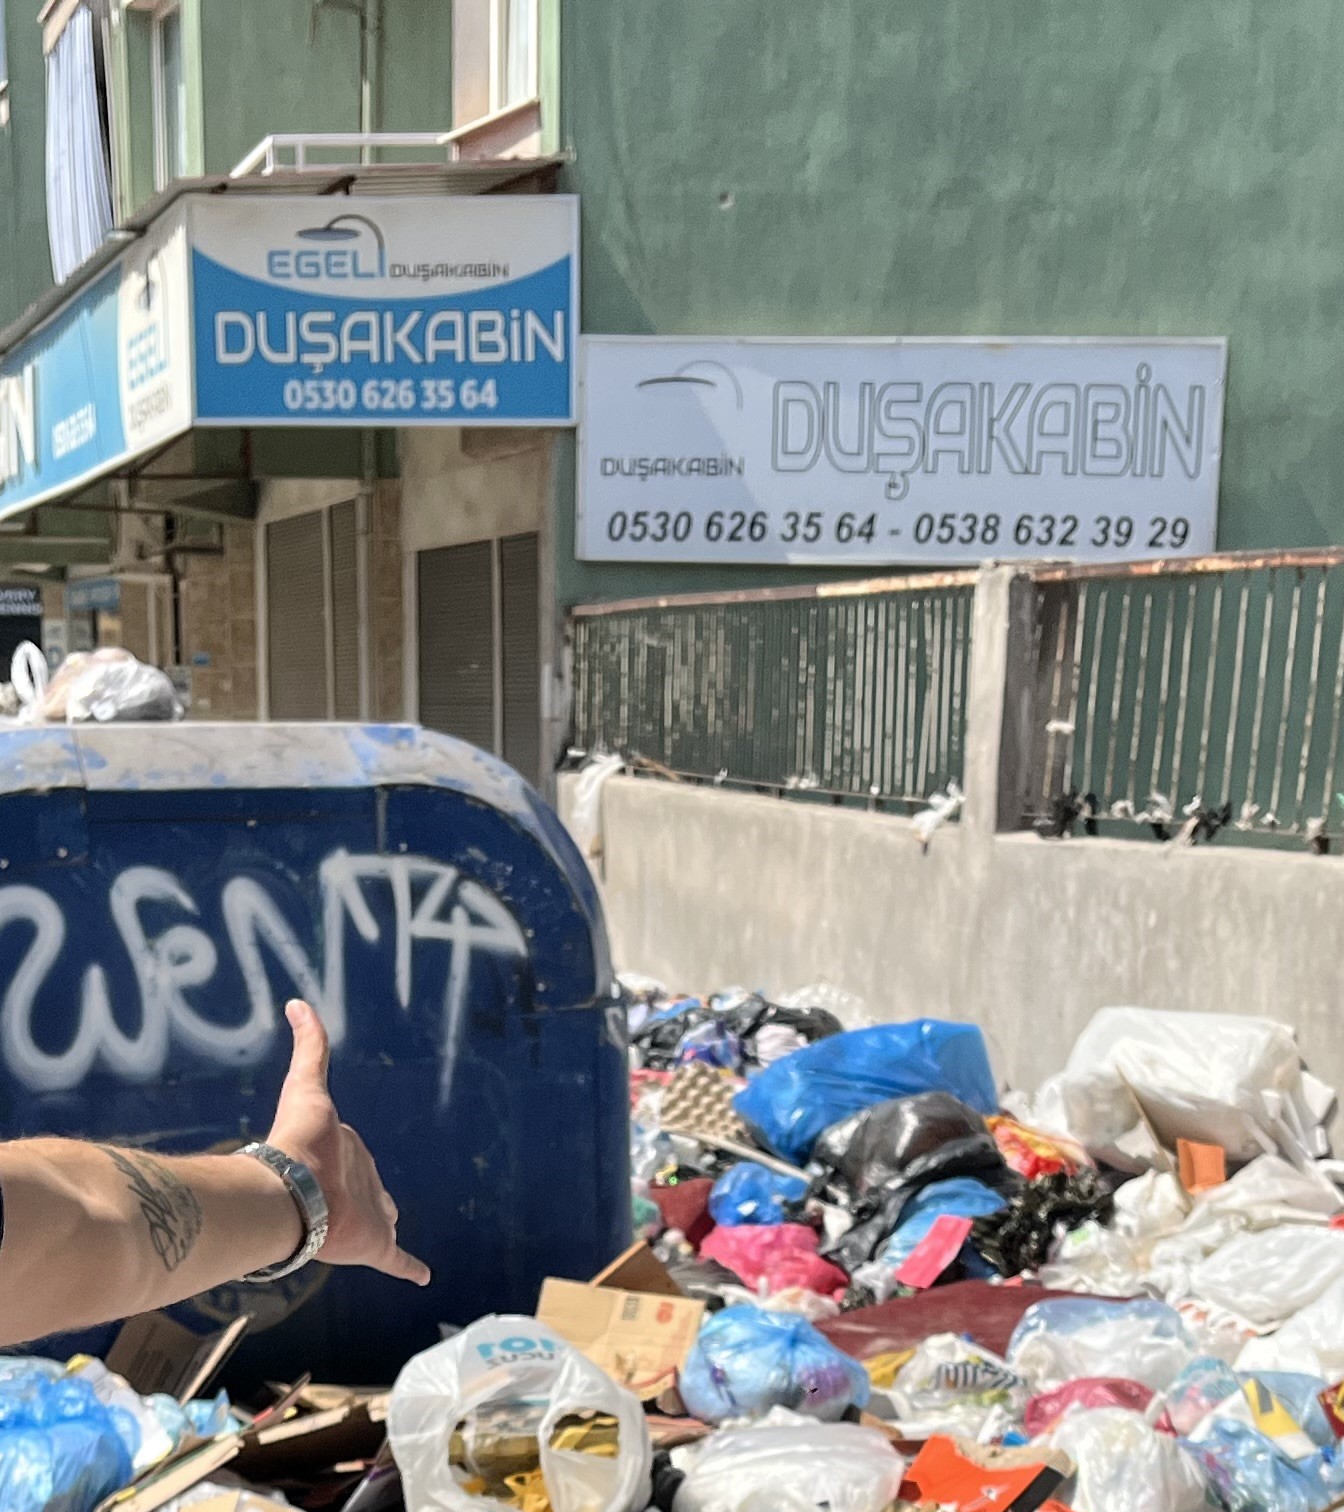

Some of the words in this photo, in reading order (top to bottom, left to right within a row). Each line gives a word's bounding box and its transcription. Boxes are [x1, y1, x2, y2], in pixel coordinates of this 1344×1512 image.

[214, 309, 565, 374] DUŞAKABİN
[283, 378, 356, 410] 0530
[361, 378, 417, 410] 626
[420, 378, 456, 410] 35
[459, 378, 500, 410] 64
[771, 362, 1207, 501] DUŞAKABİN
[600, 450, 746, 482] DUŞAKABİN
[607, 511, 692, 542] 0530
[704, 511, 768, 543] 626
[780, 512, 823, 544] 35
[834, 512, 877, 544] 64
[913, 513, 1001, 545] 0538
[1013, 514, 1078, 546] 632
[1091, 515, 1134, 547] 39
[1146, 516, 1191, 549] 29
